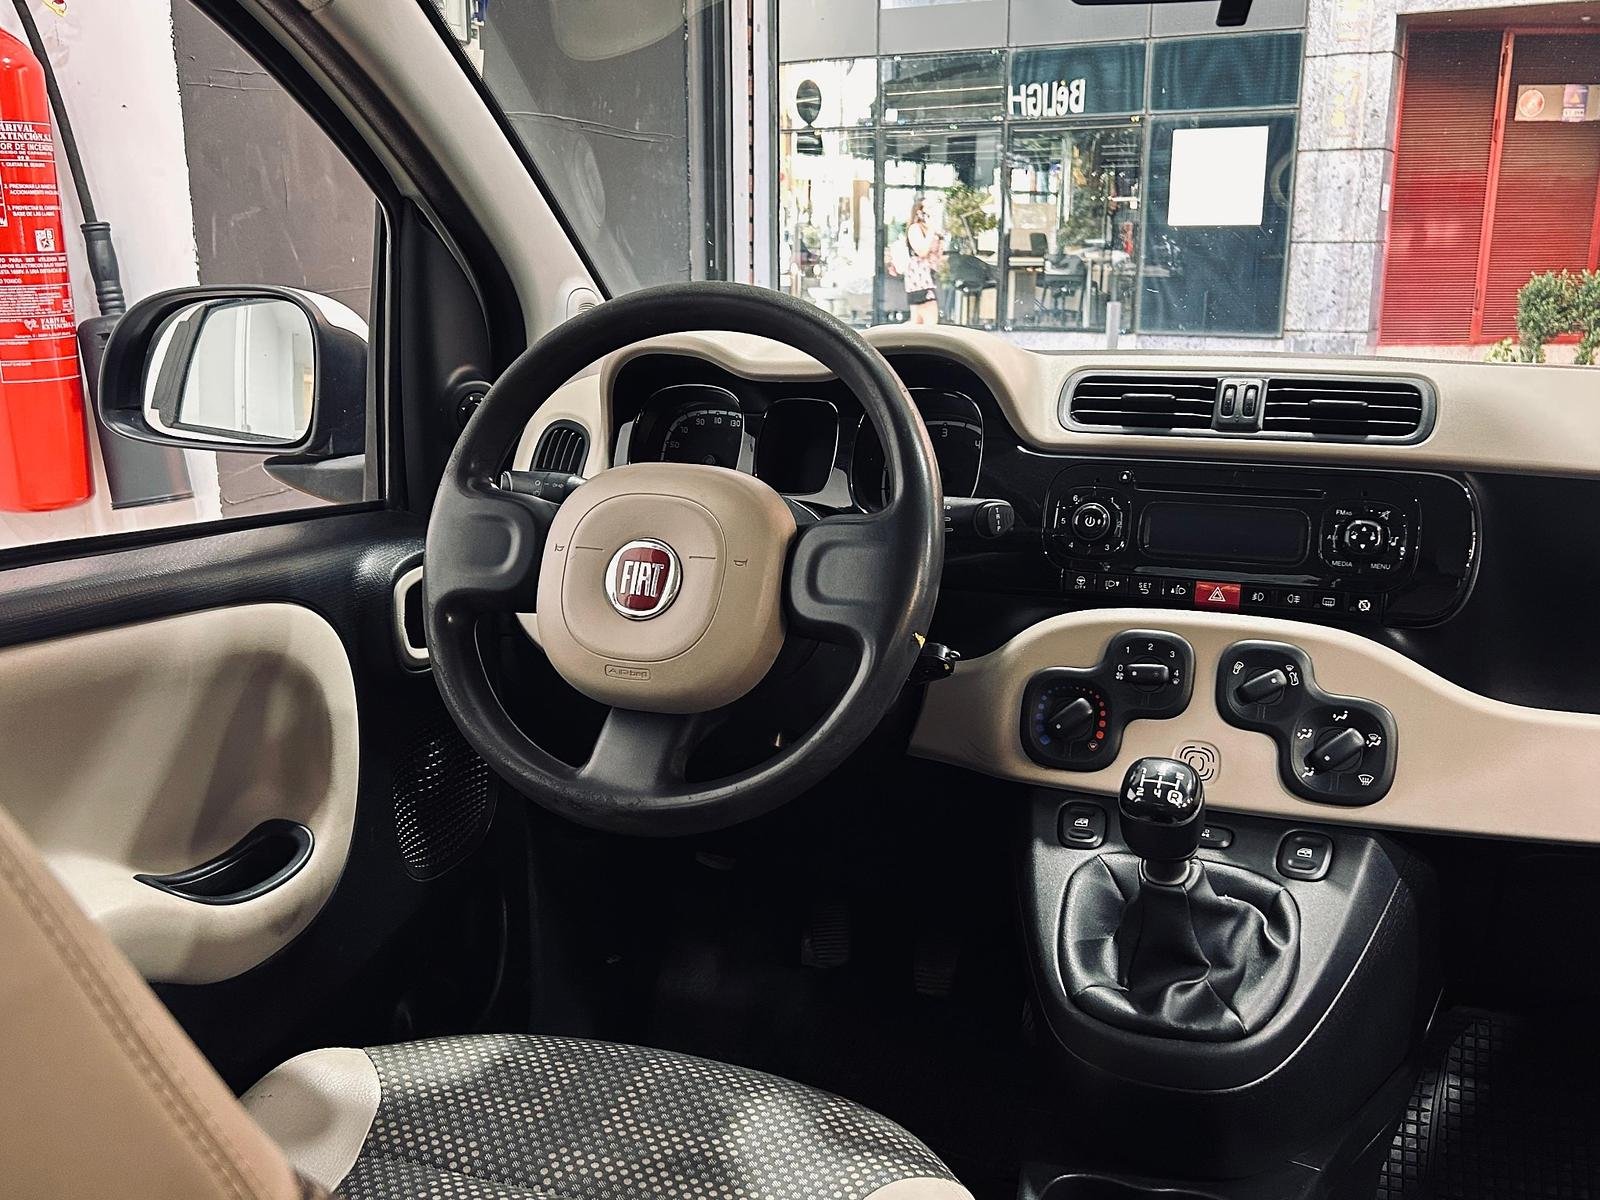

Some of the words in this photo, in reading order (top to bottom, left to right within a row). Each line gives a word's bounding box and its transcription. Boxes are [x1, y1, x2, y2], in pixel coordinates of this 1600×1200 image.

[941, 428, 948, 437] 3
[620, 560, 664, 597] FIAT
[1126, 646, 1130, 654] 1
[1174, 669, 1179, 677] 4
[1136, 787, 1144, 796] 2
[1154, 788, 1162, 798] 4
